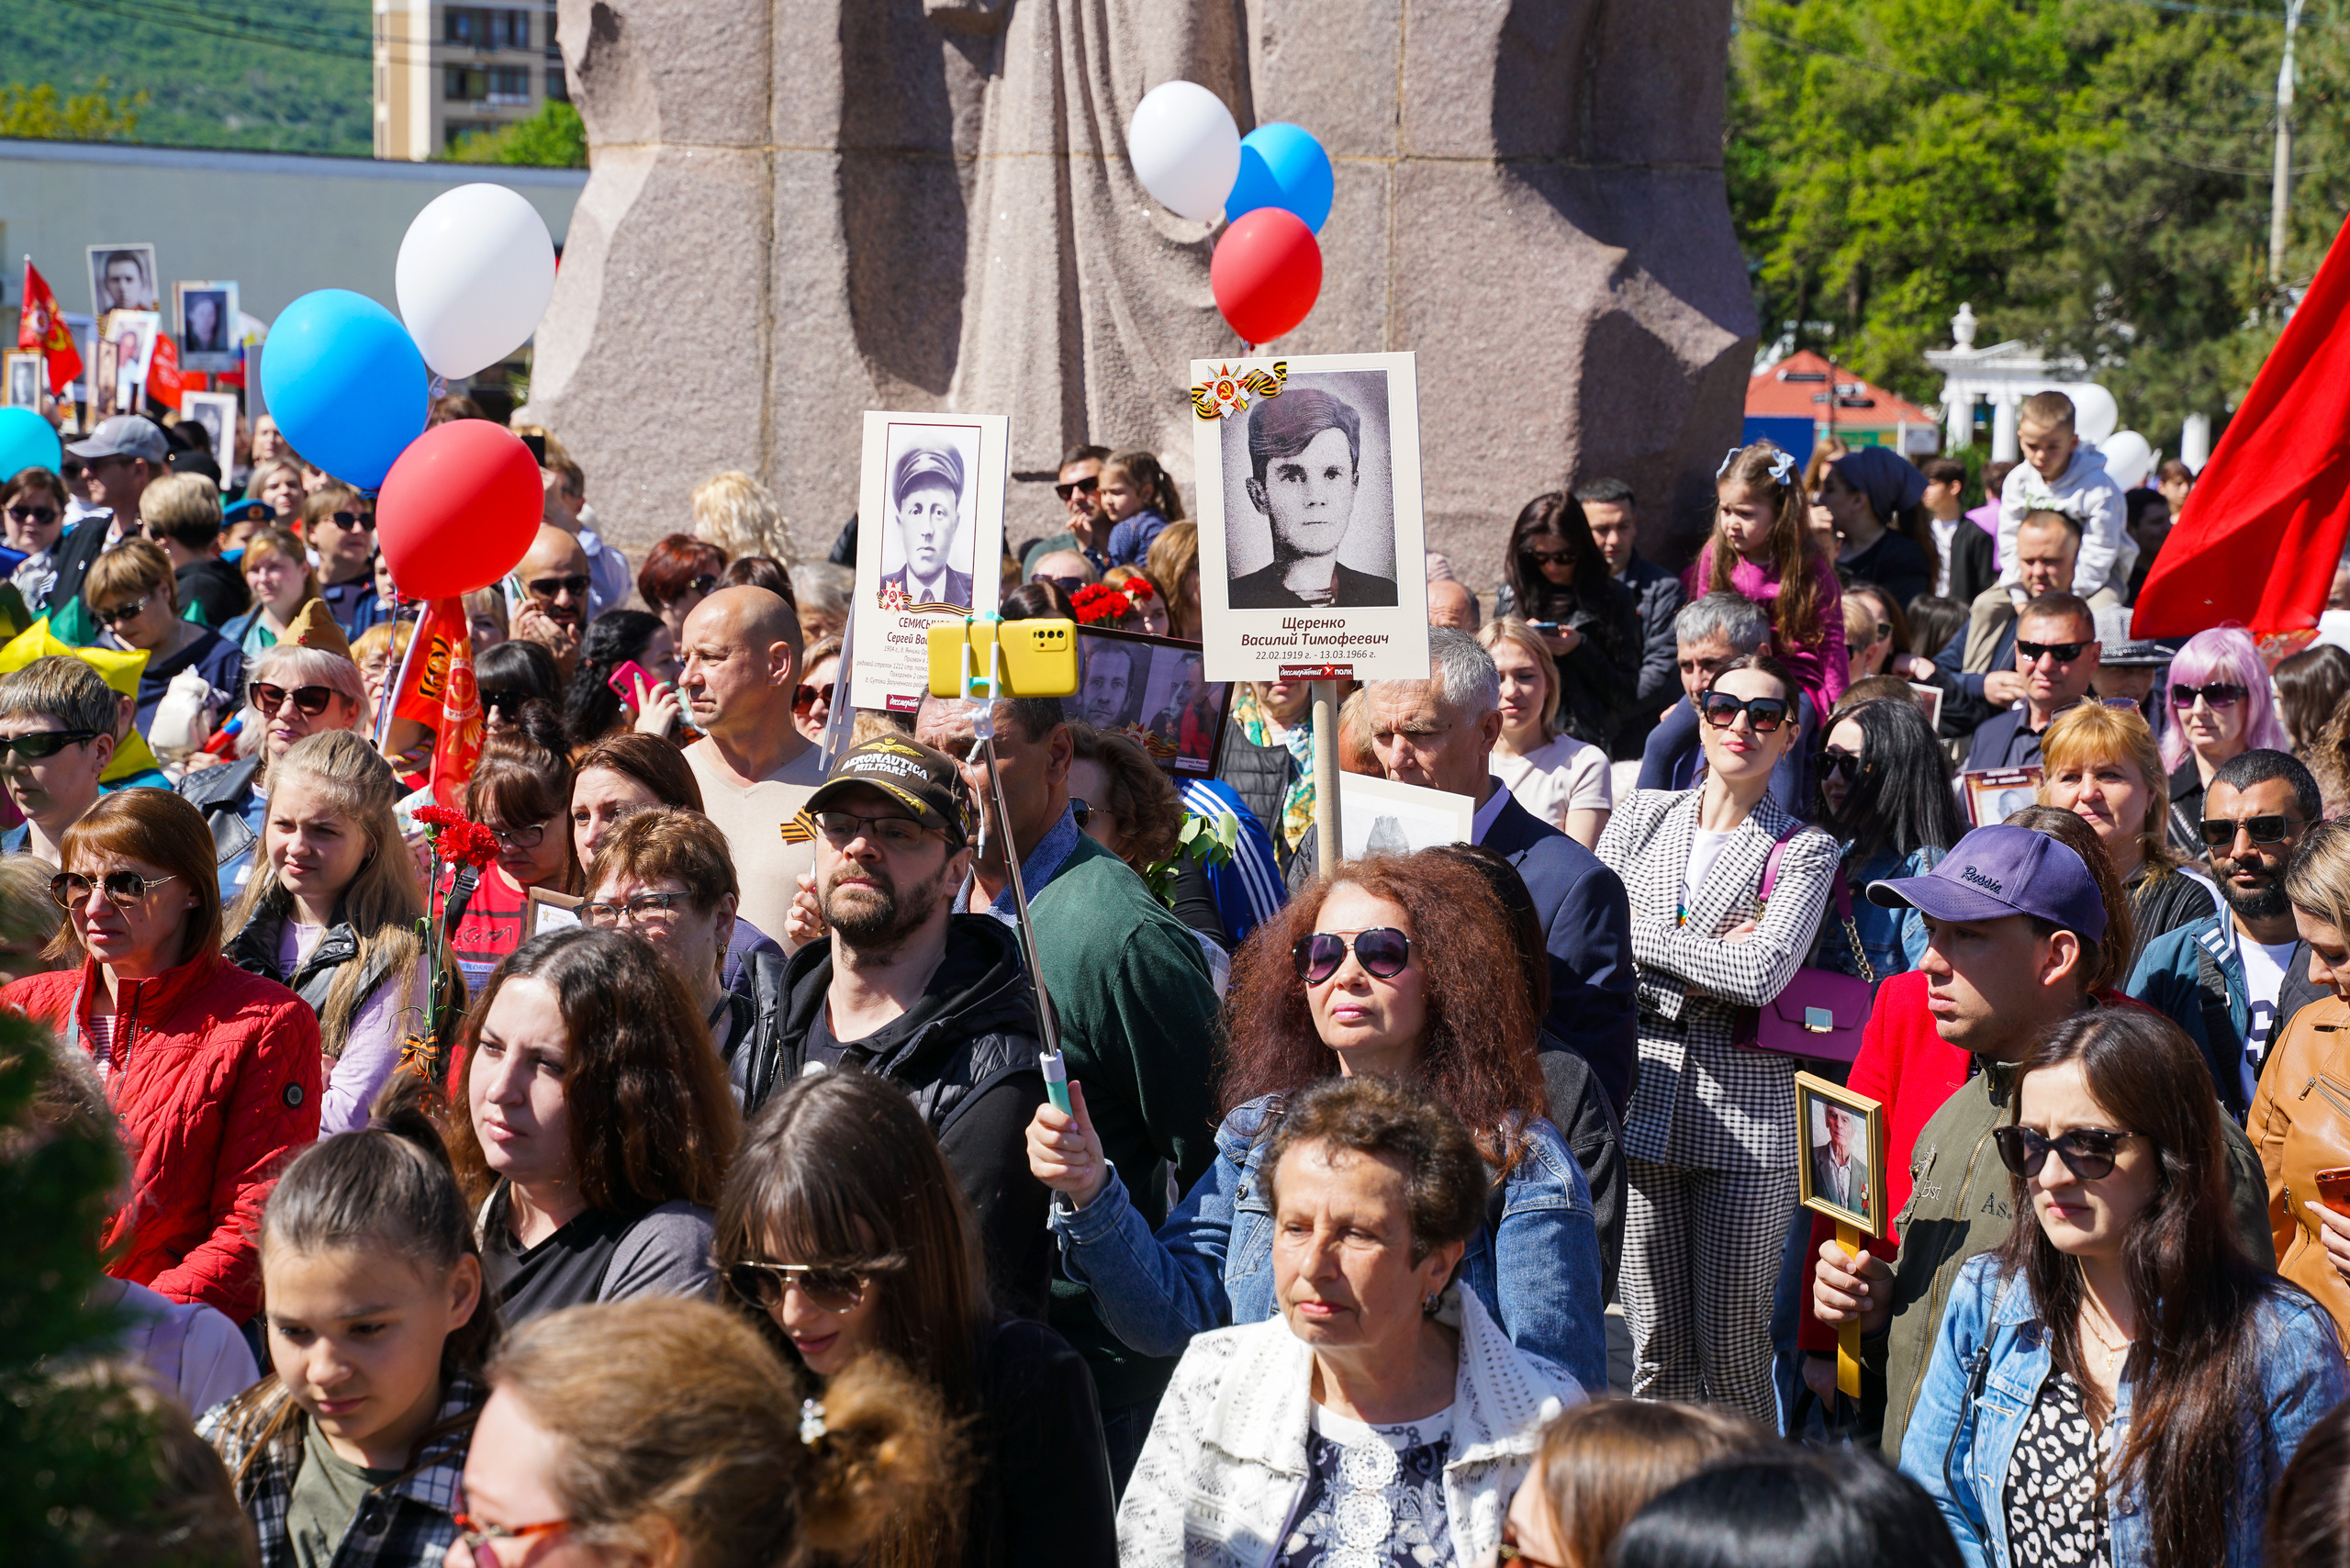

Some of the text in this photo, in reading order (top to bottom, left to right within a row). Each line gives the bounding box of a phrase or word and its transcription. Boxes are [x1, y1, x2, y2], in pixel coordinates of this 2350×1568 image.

[899, 617, 950, 630] СЕМИСЫ
[1281, 617, 1346, 631] Щеренко
[887, 632, 928, 644] Сергей Вас
[1241, 633, 1390, 647] Василий Тимофеевич
[1256, 651, 1303, 660] 22.02.1919
[1320, 650, 1367, 659] 13.03.1966
[841, 753, 928, 780] AERONAUTICA
[854, 763, 908, 778] MILITARE
[1961, 865, 2002, 894] Russia
